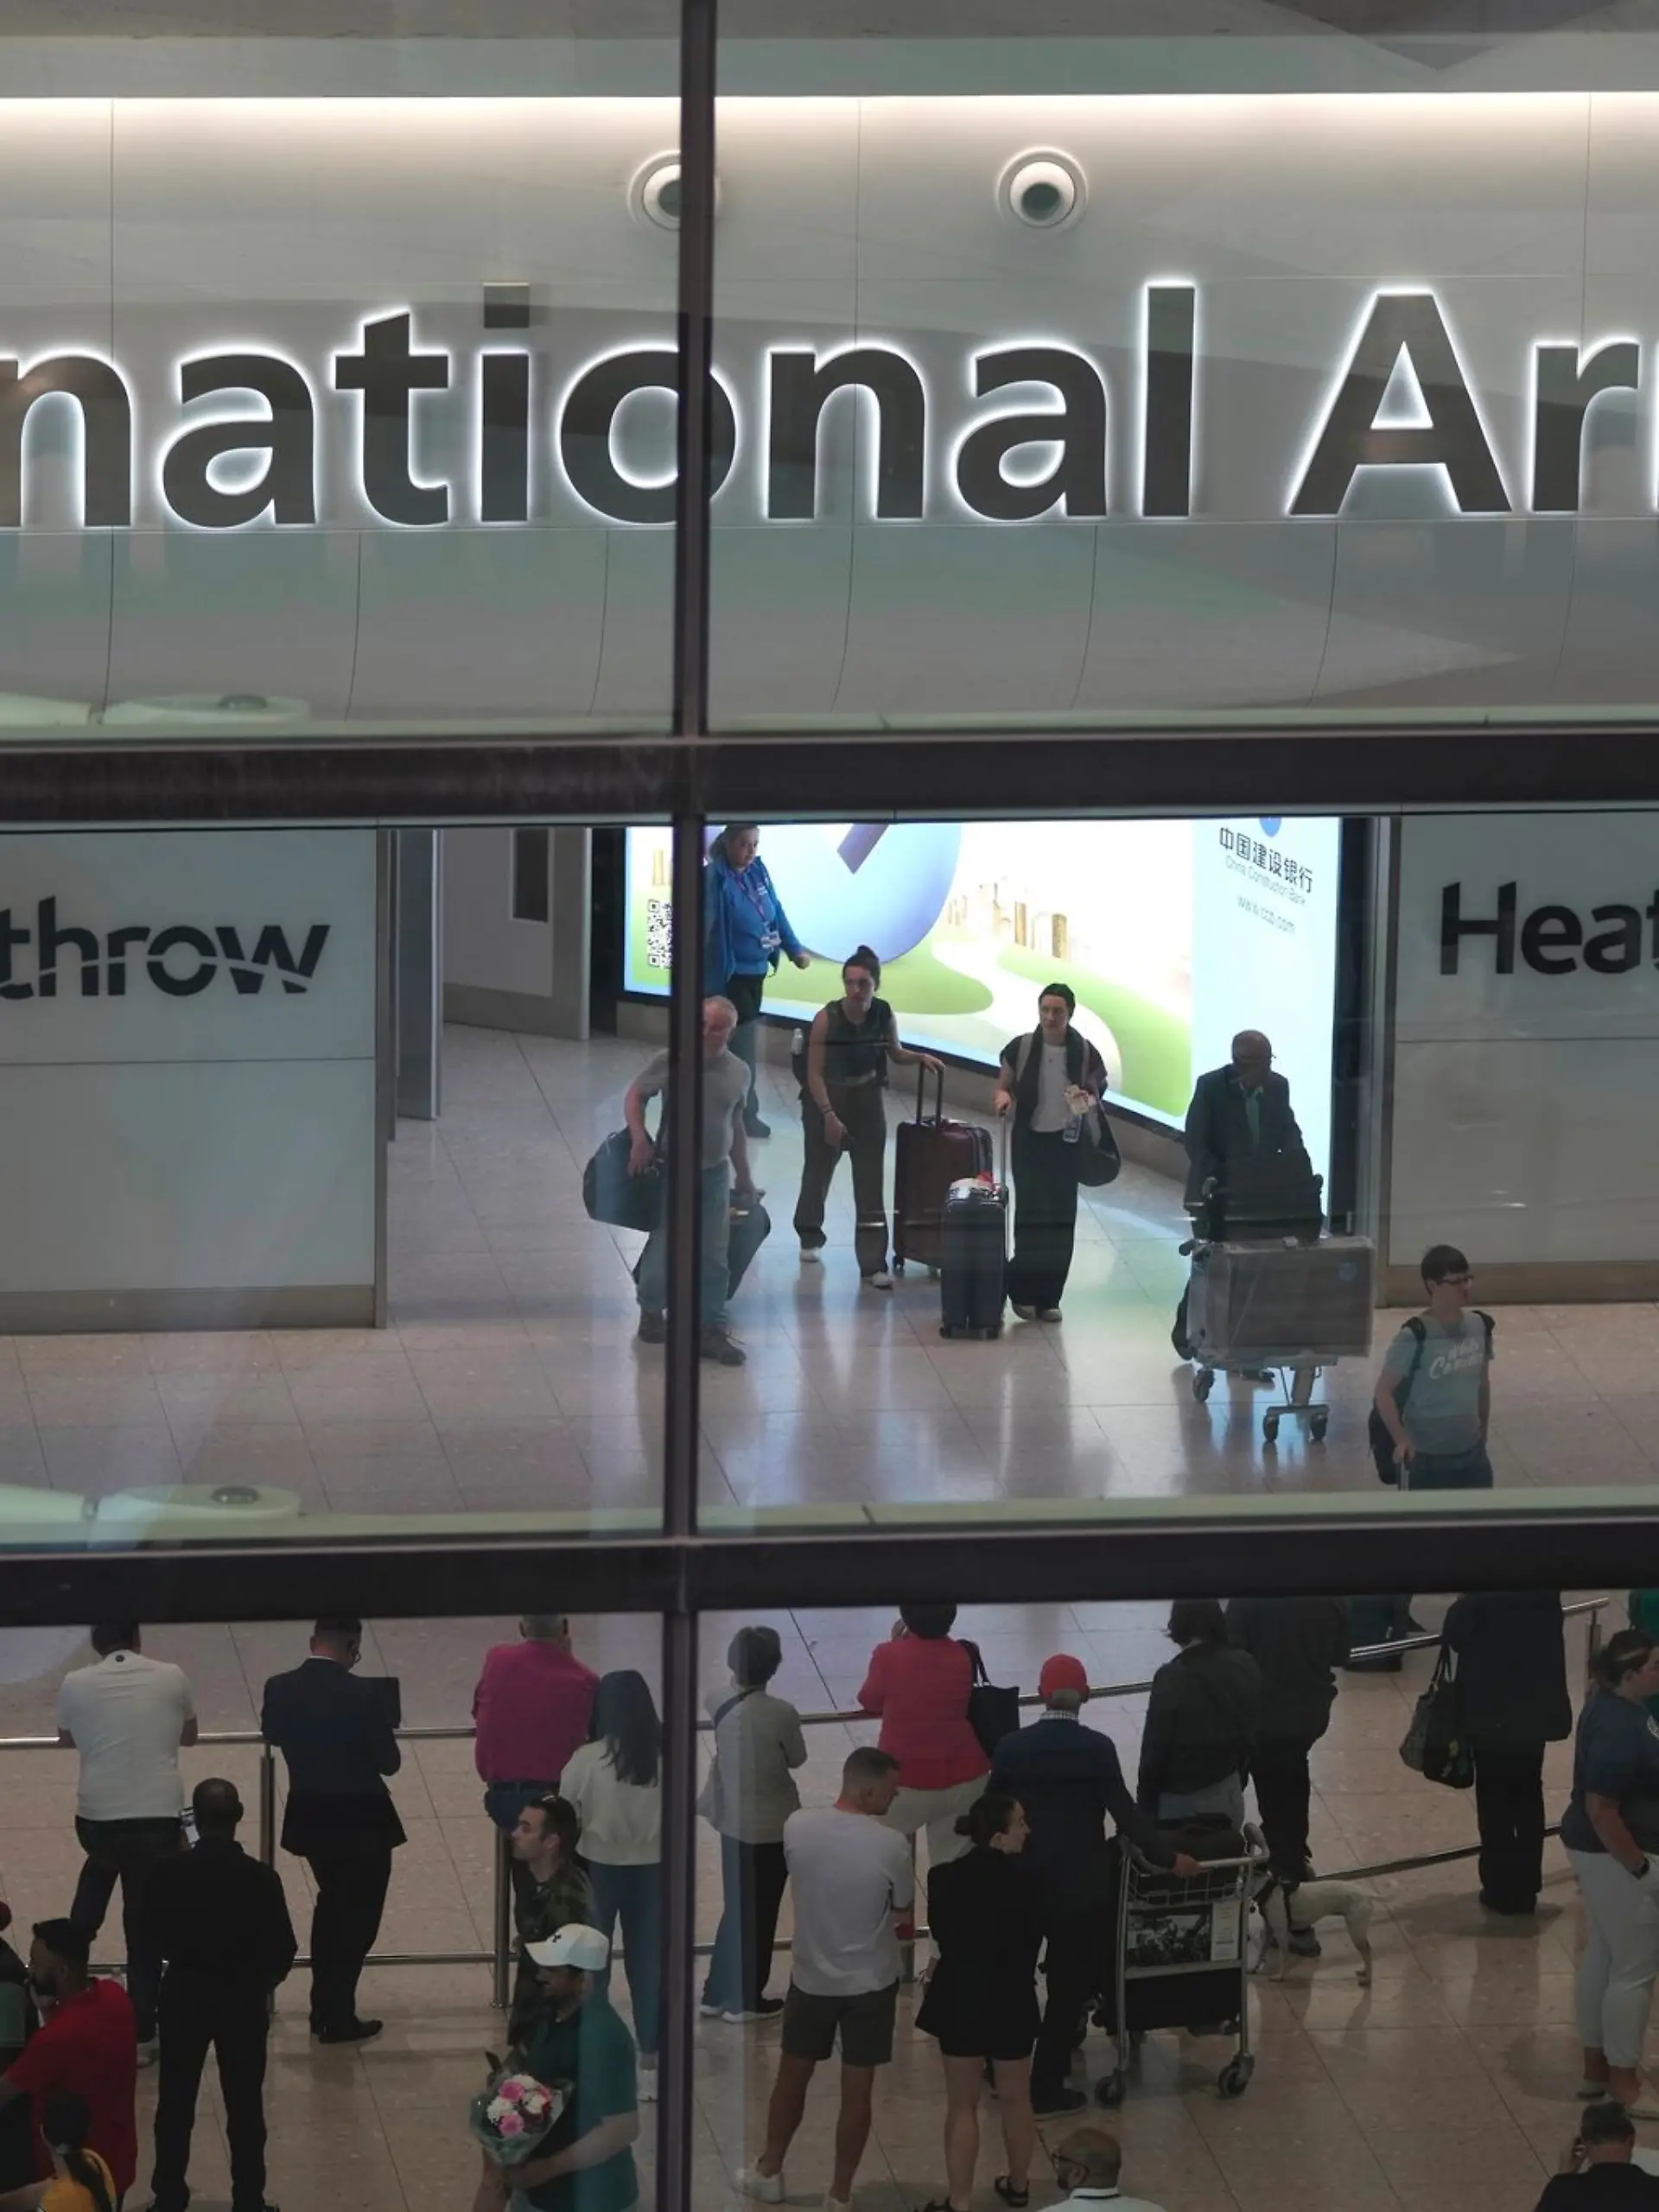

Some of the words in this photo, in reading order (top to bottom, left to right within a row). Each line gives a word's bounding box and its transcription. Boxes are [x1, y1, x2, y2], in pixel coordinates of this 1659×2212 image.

[1287, 291, 1659, 515] Ar
[1219, 826, 1313, 893] 中国建设银行
